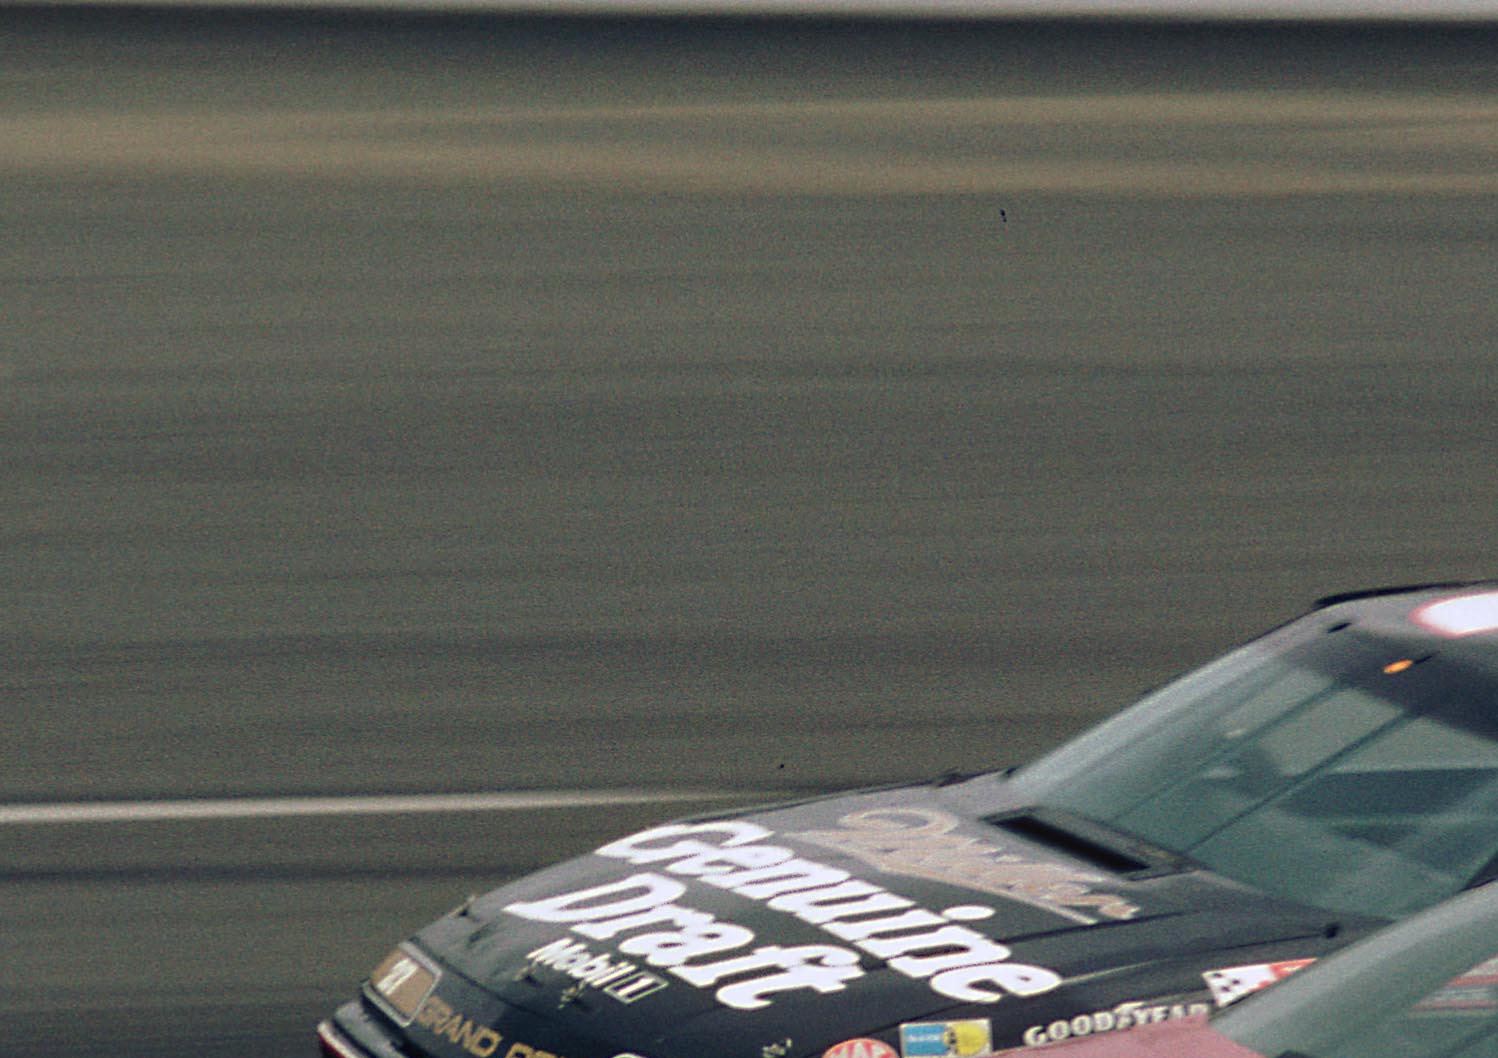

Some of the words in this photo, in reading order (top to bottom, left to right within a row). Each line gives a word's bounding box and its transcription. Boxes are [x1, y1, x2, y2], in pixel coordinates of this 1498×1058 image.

[503, 871, 868, 1011] Draft
[526, 937, 638, 988] Mobil
[594, 820, 1063, 1003] Genuine
[415, 994, 502, 1058] GRAND
